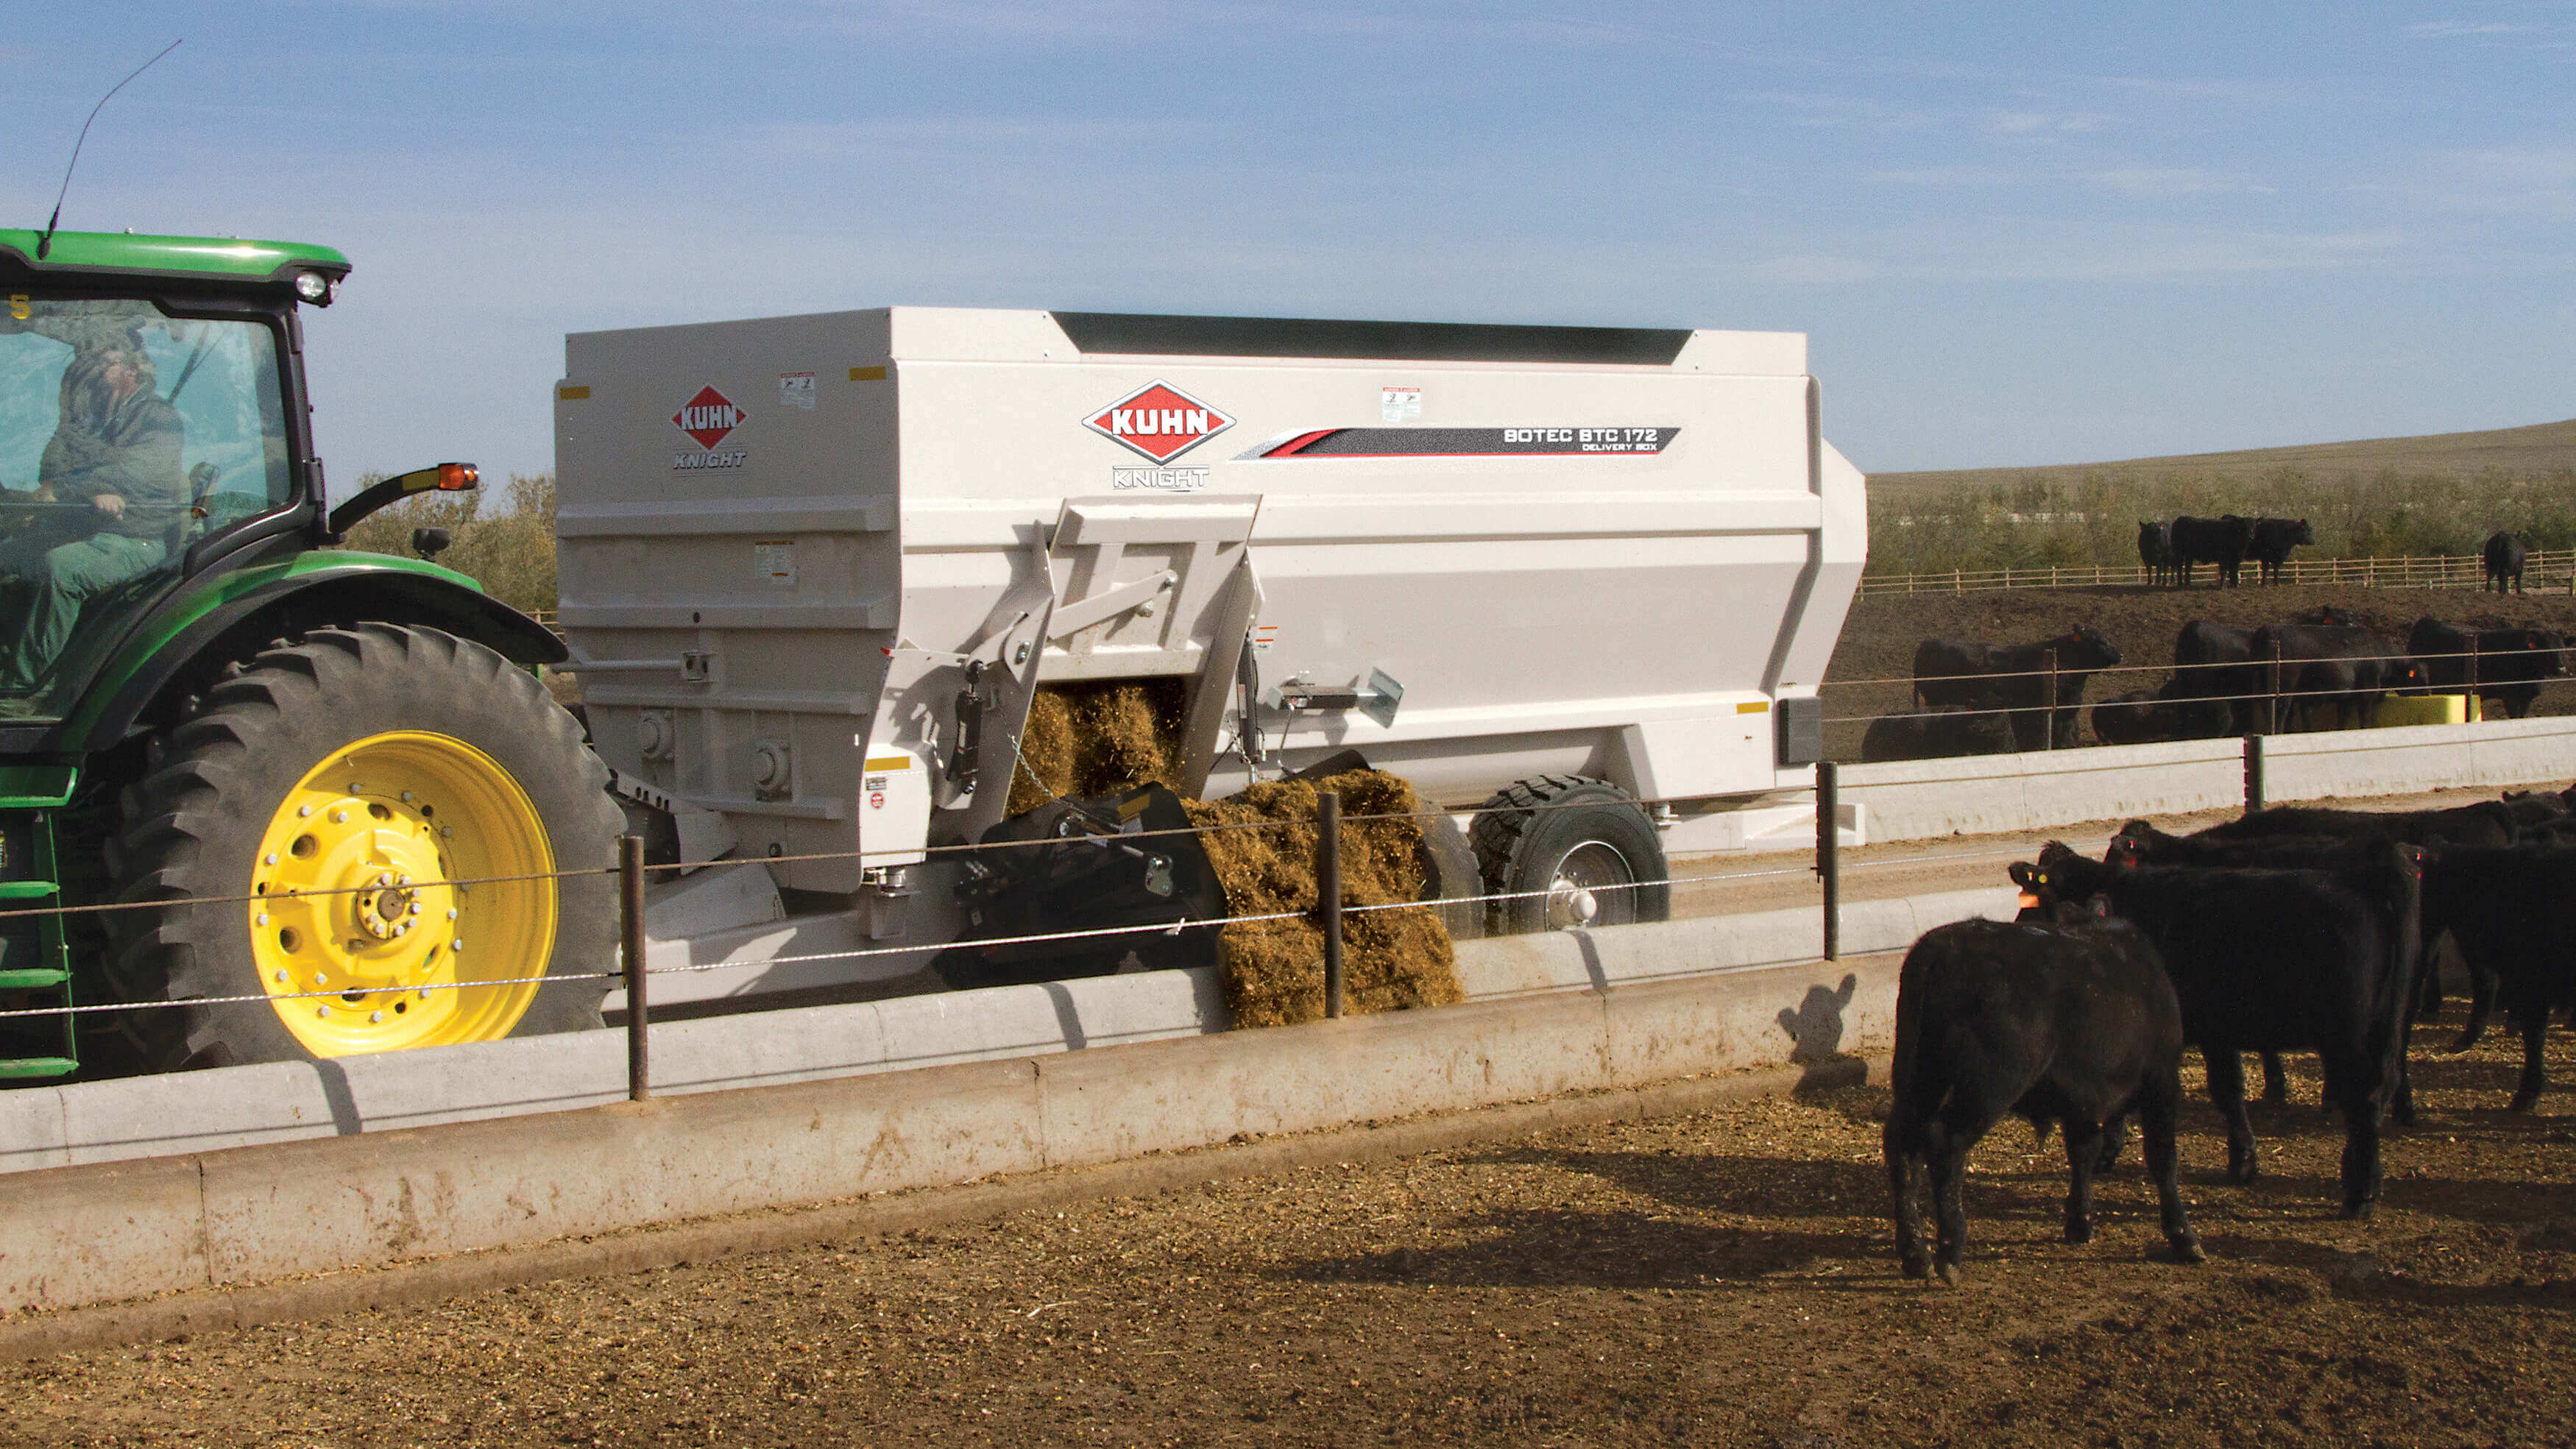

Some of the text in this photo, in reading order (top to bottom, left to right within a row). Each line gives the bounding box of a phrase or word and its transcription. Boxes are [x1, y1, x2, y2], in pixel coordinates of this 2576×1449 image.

[682, 405, 737, 431] KUHN
[1111, 409, 1209, 435] KUHN
[1504, 428, 1658, 442] BOTEC BTC 172
[673, 452, 747, 470] KNIGHT
[1114, 470, 1209, 487] KNIGHT
